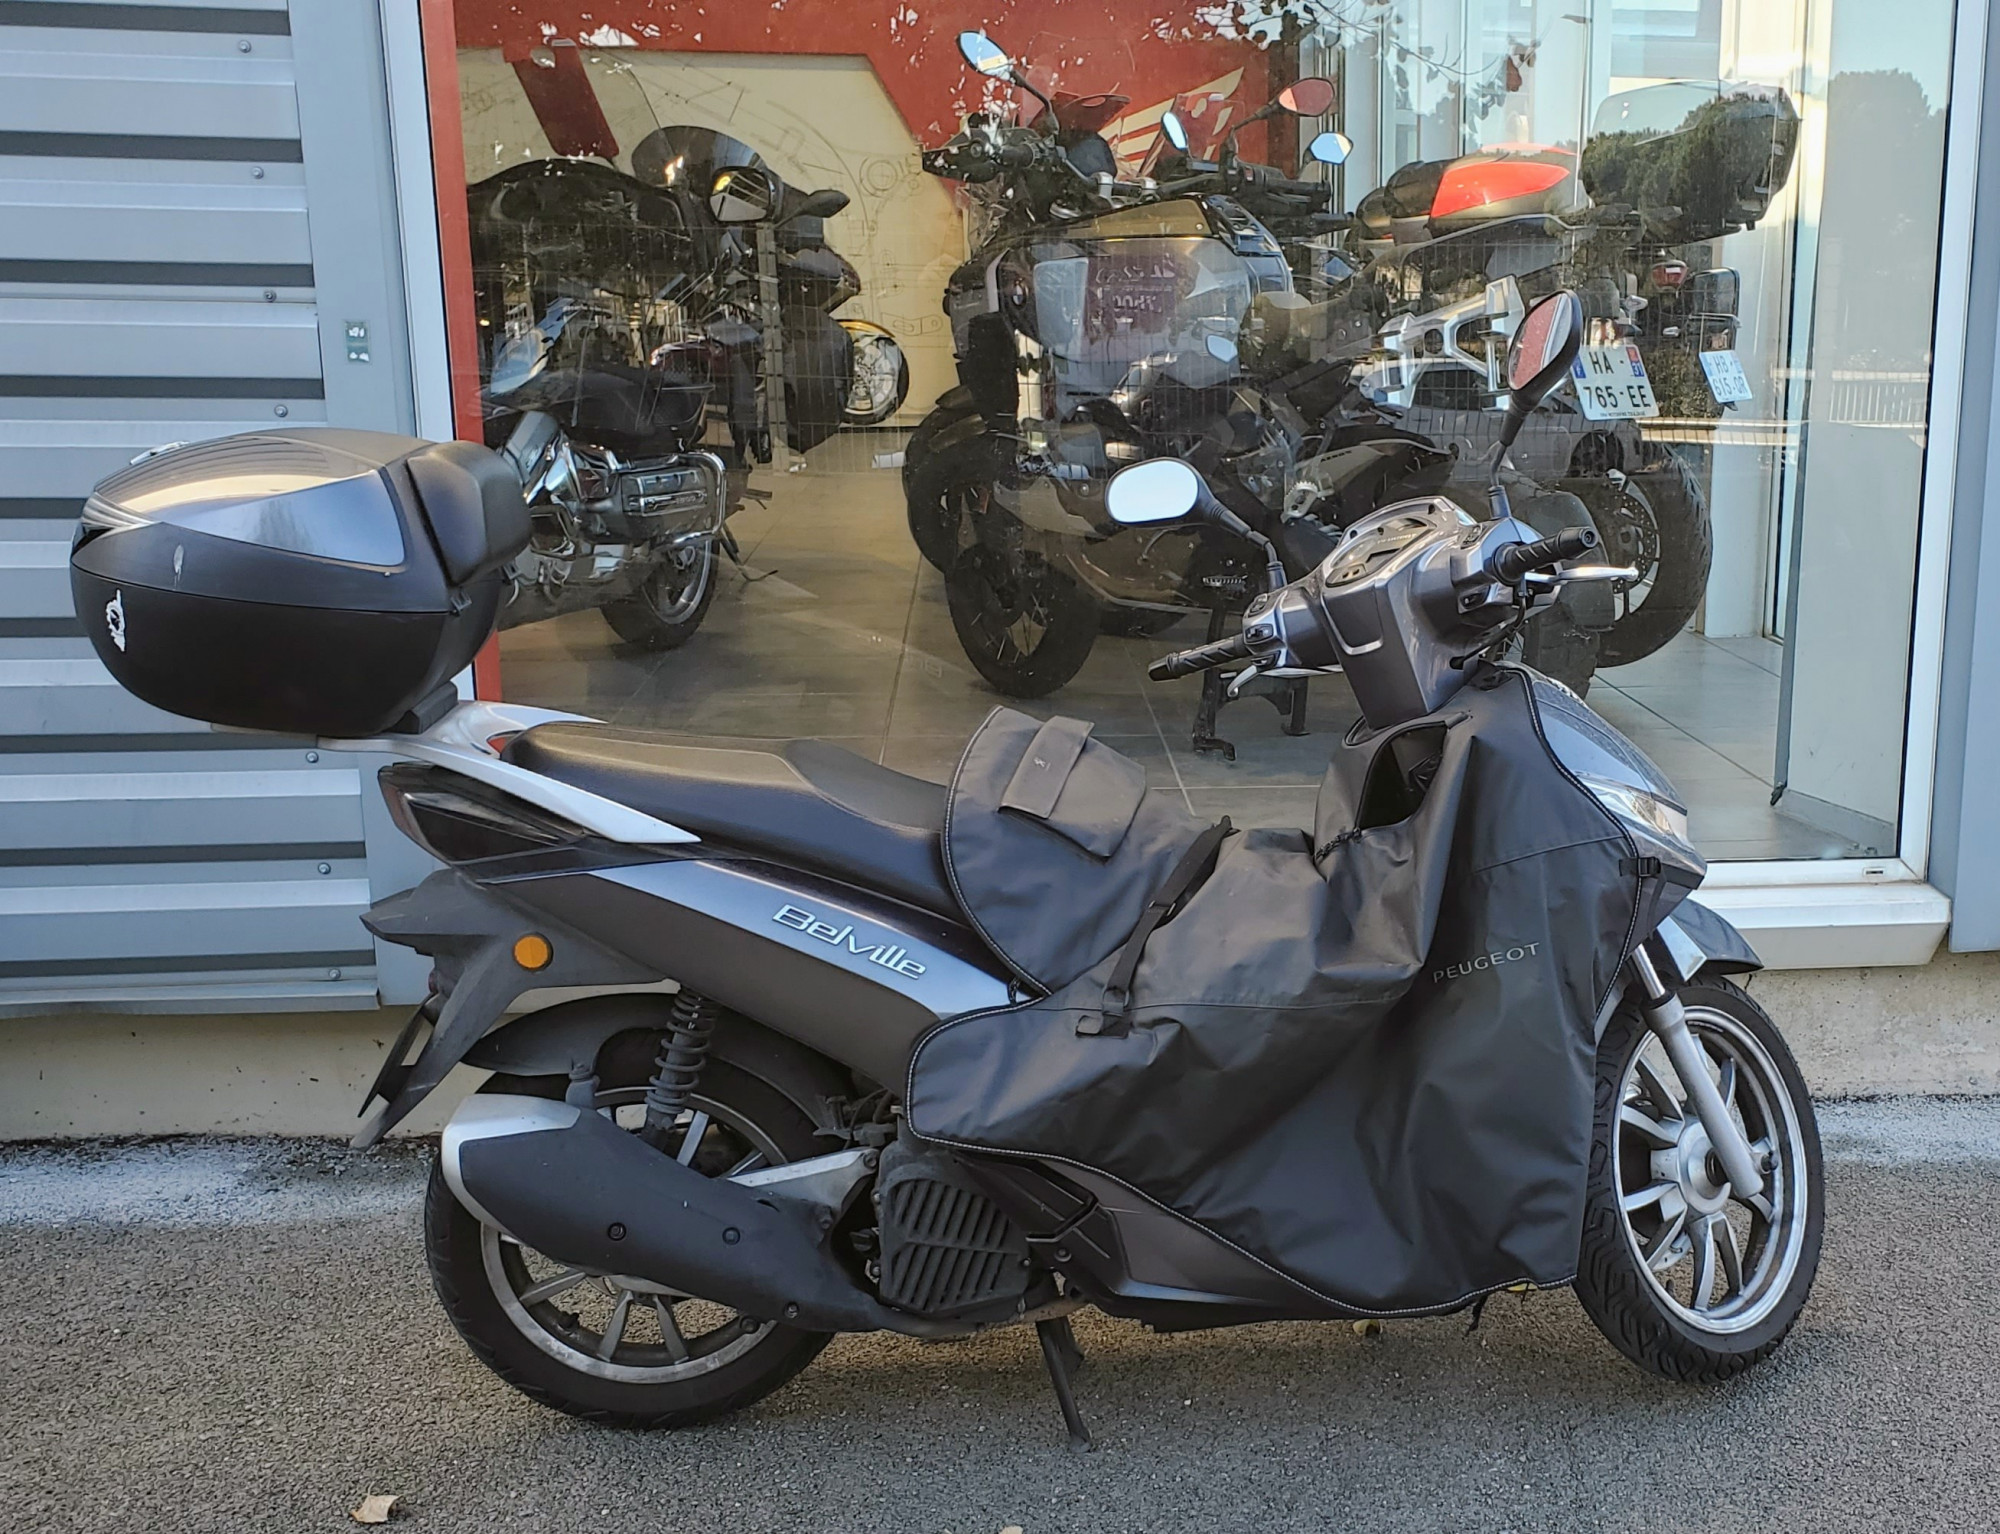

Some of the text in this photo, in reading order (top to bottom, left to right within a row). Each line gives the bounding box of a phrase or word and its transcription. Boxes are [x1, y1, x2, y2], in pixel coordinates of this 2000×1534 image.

[1632, 362, 1644, 375] 31
[1583, 385, 1651, 409] 765-EE
[771, 903, 927, 981] Belville
[1433, 942, 1540, 984] PEUGEOT
